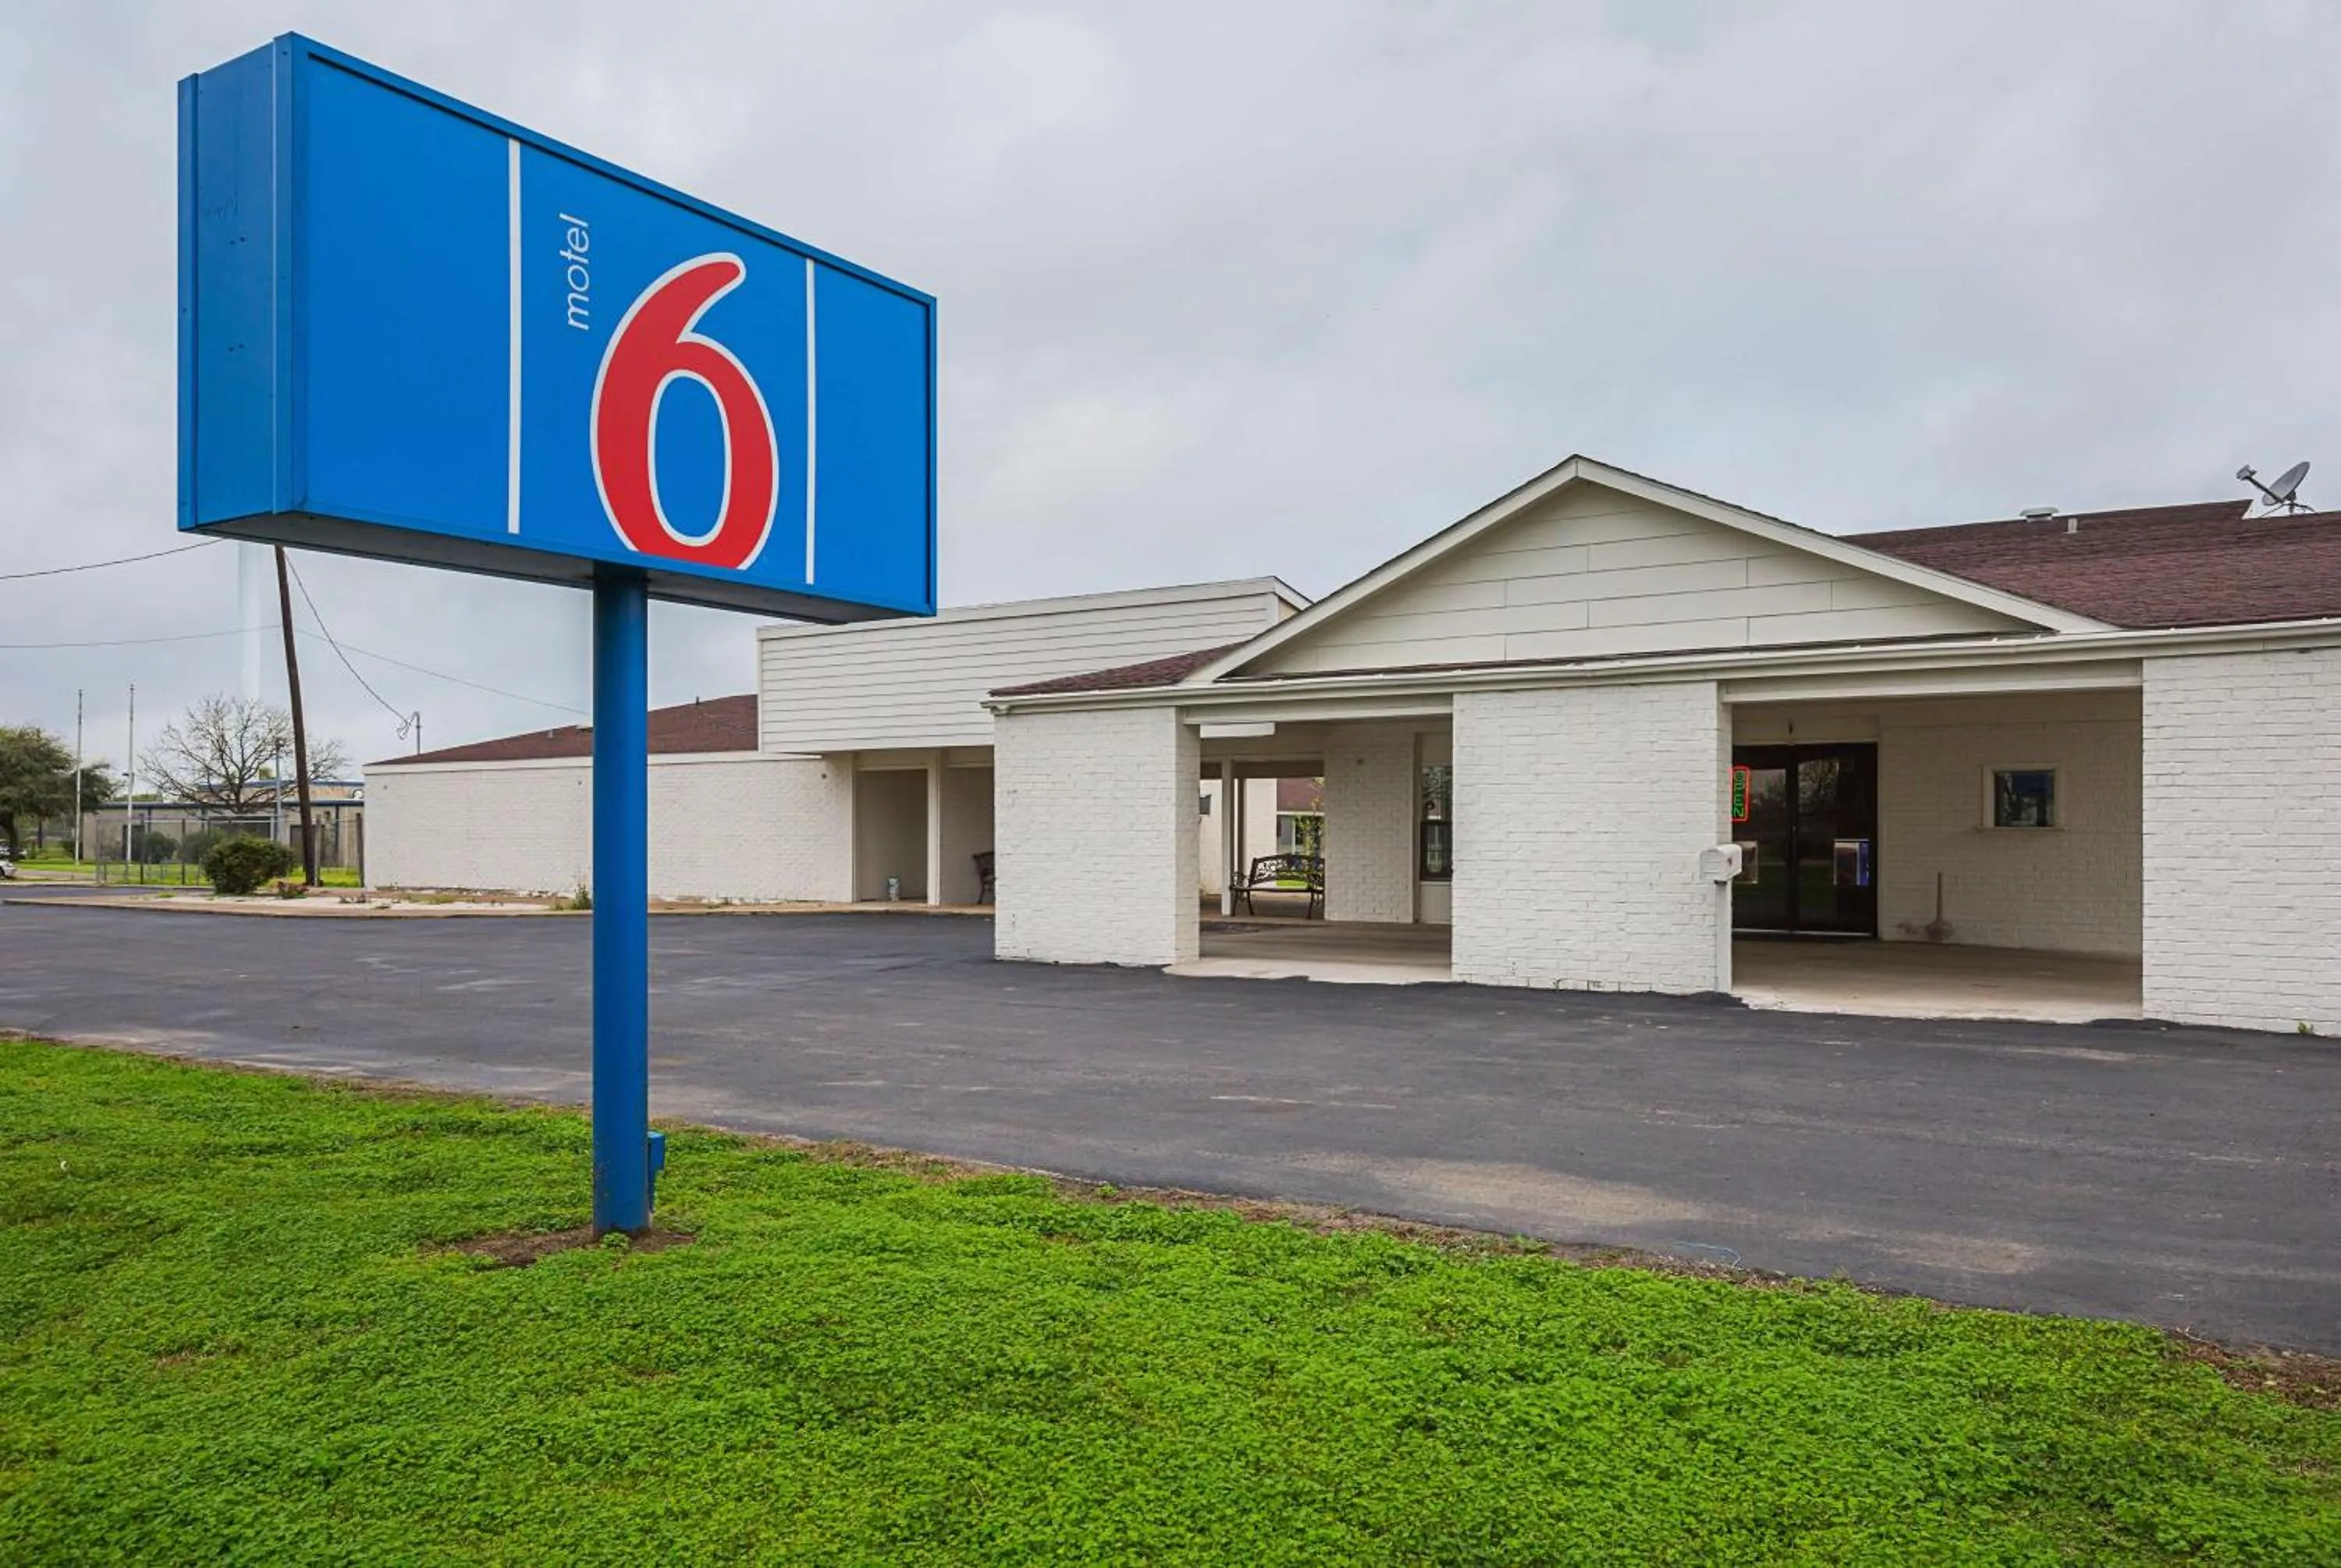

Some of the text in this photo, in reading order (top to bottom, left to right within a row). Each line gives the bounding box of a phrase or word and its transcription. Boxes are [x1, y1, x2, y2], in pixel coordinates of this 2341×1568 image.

[559, 212, 779, 570] motel 6
[1732, 770, 1746, 818] OPEN
